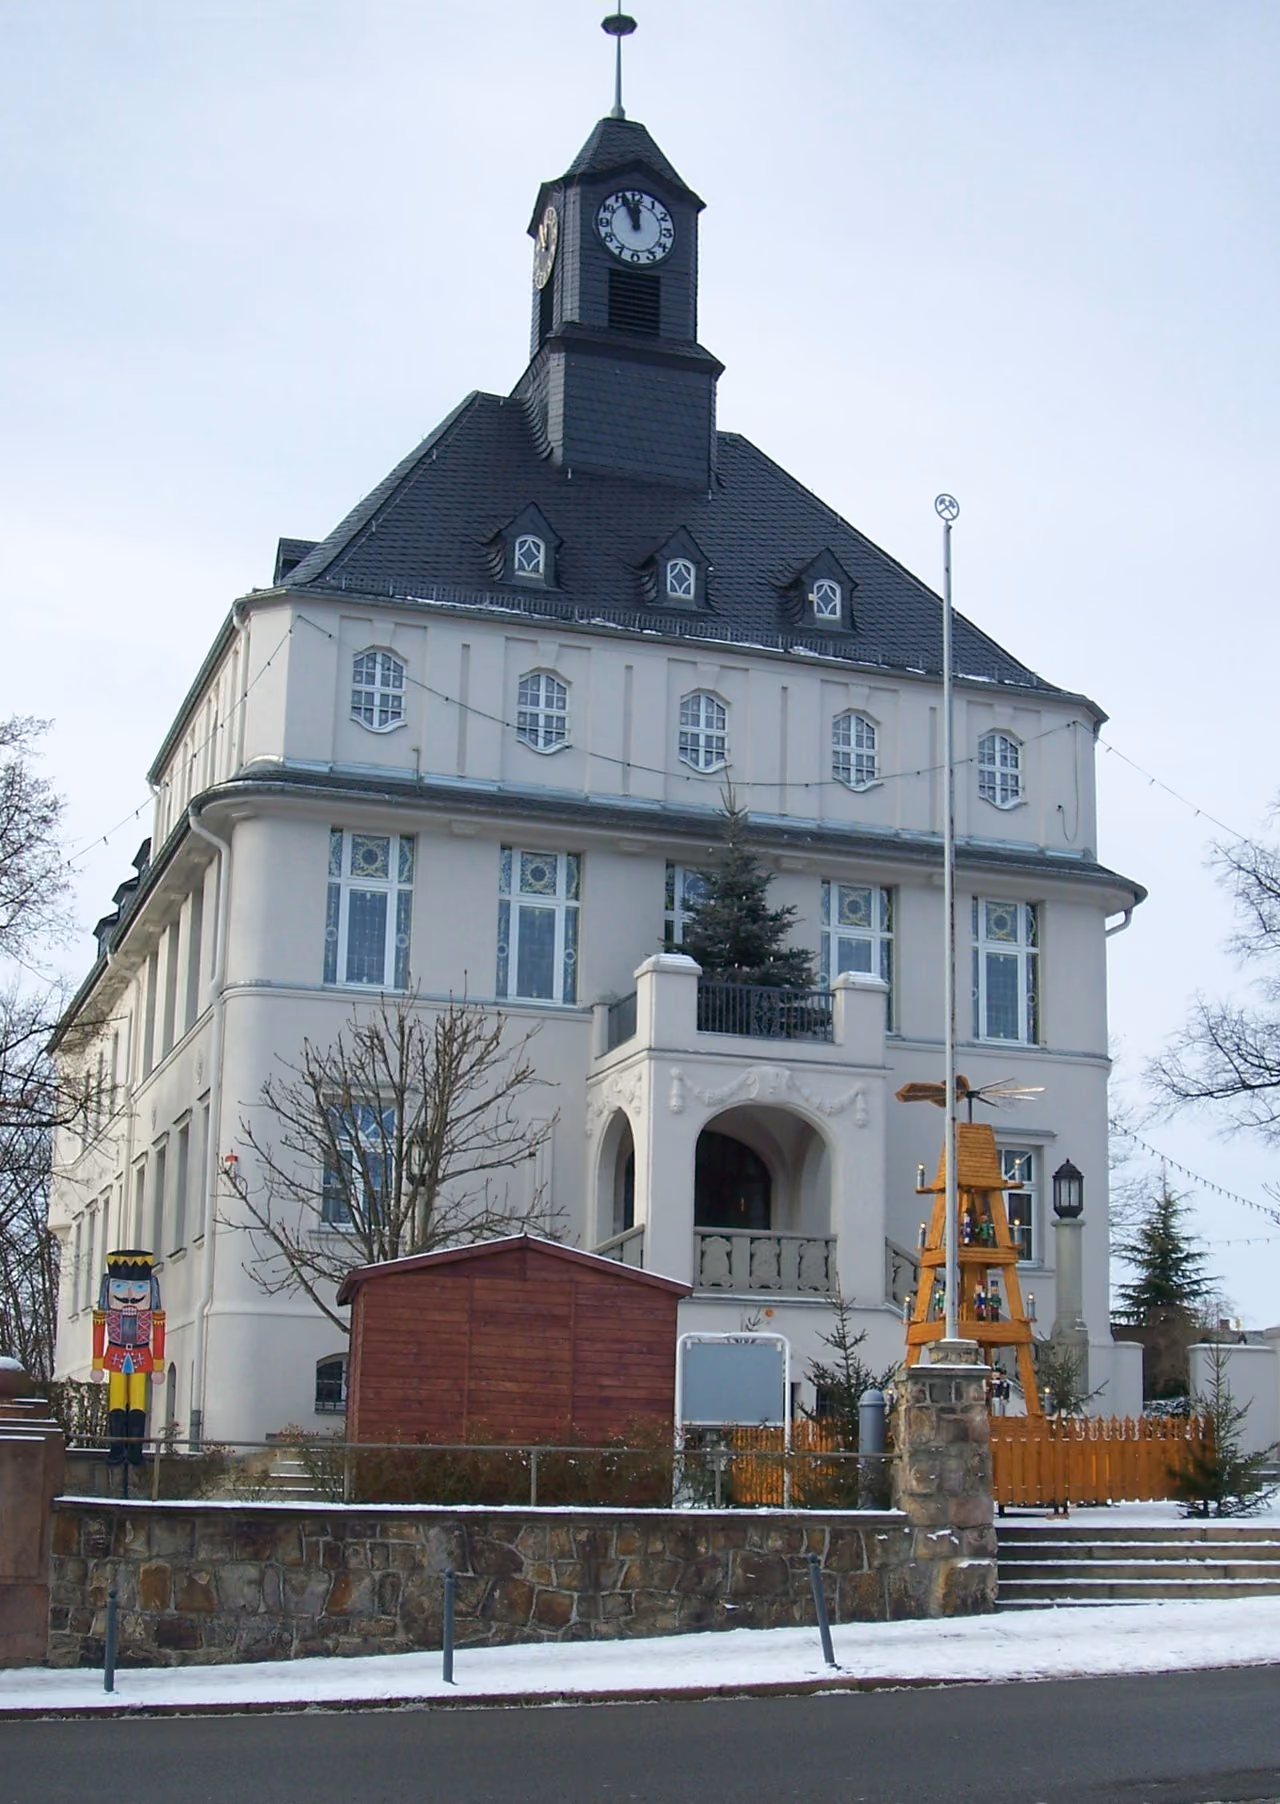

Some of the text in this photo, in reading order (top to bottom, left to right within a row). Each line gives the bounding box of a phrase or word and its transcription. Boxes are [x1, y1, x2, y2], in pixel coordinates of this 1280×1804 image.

[650, 200, 656, 210] 1
[600, 217, 609, 227] 9
[659, 212, 668, 222] 2
[604, 232, 613, 243] 8
[662, 228, 673, 239] 3
[615, 245, 624, 257] 7
[659, 243, 668, 253] 4
[630, 252, 640, 262] 6
[646, 249, 656, 262] 5
